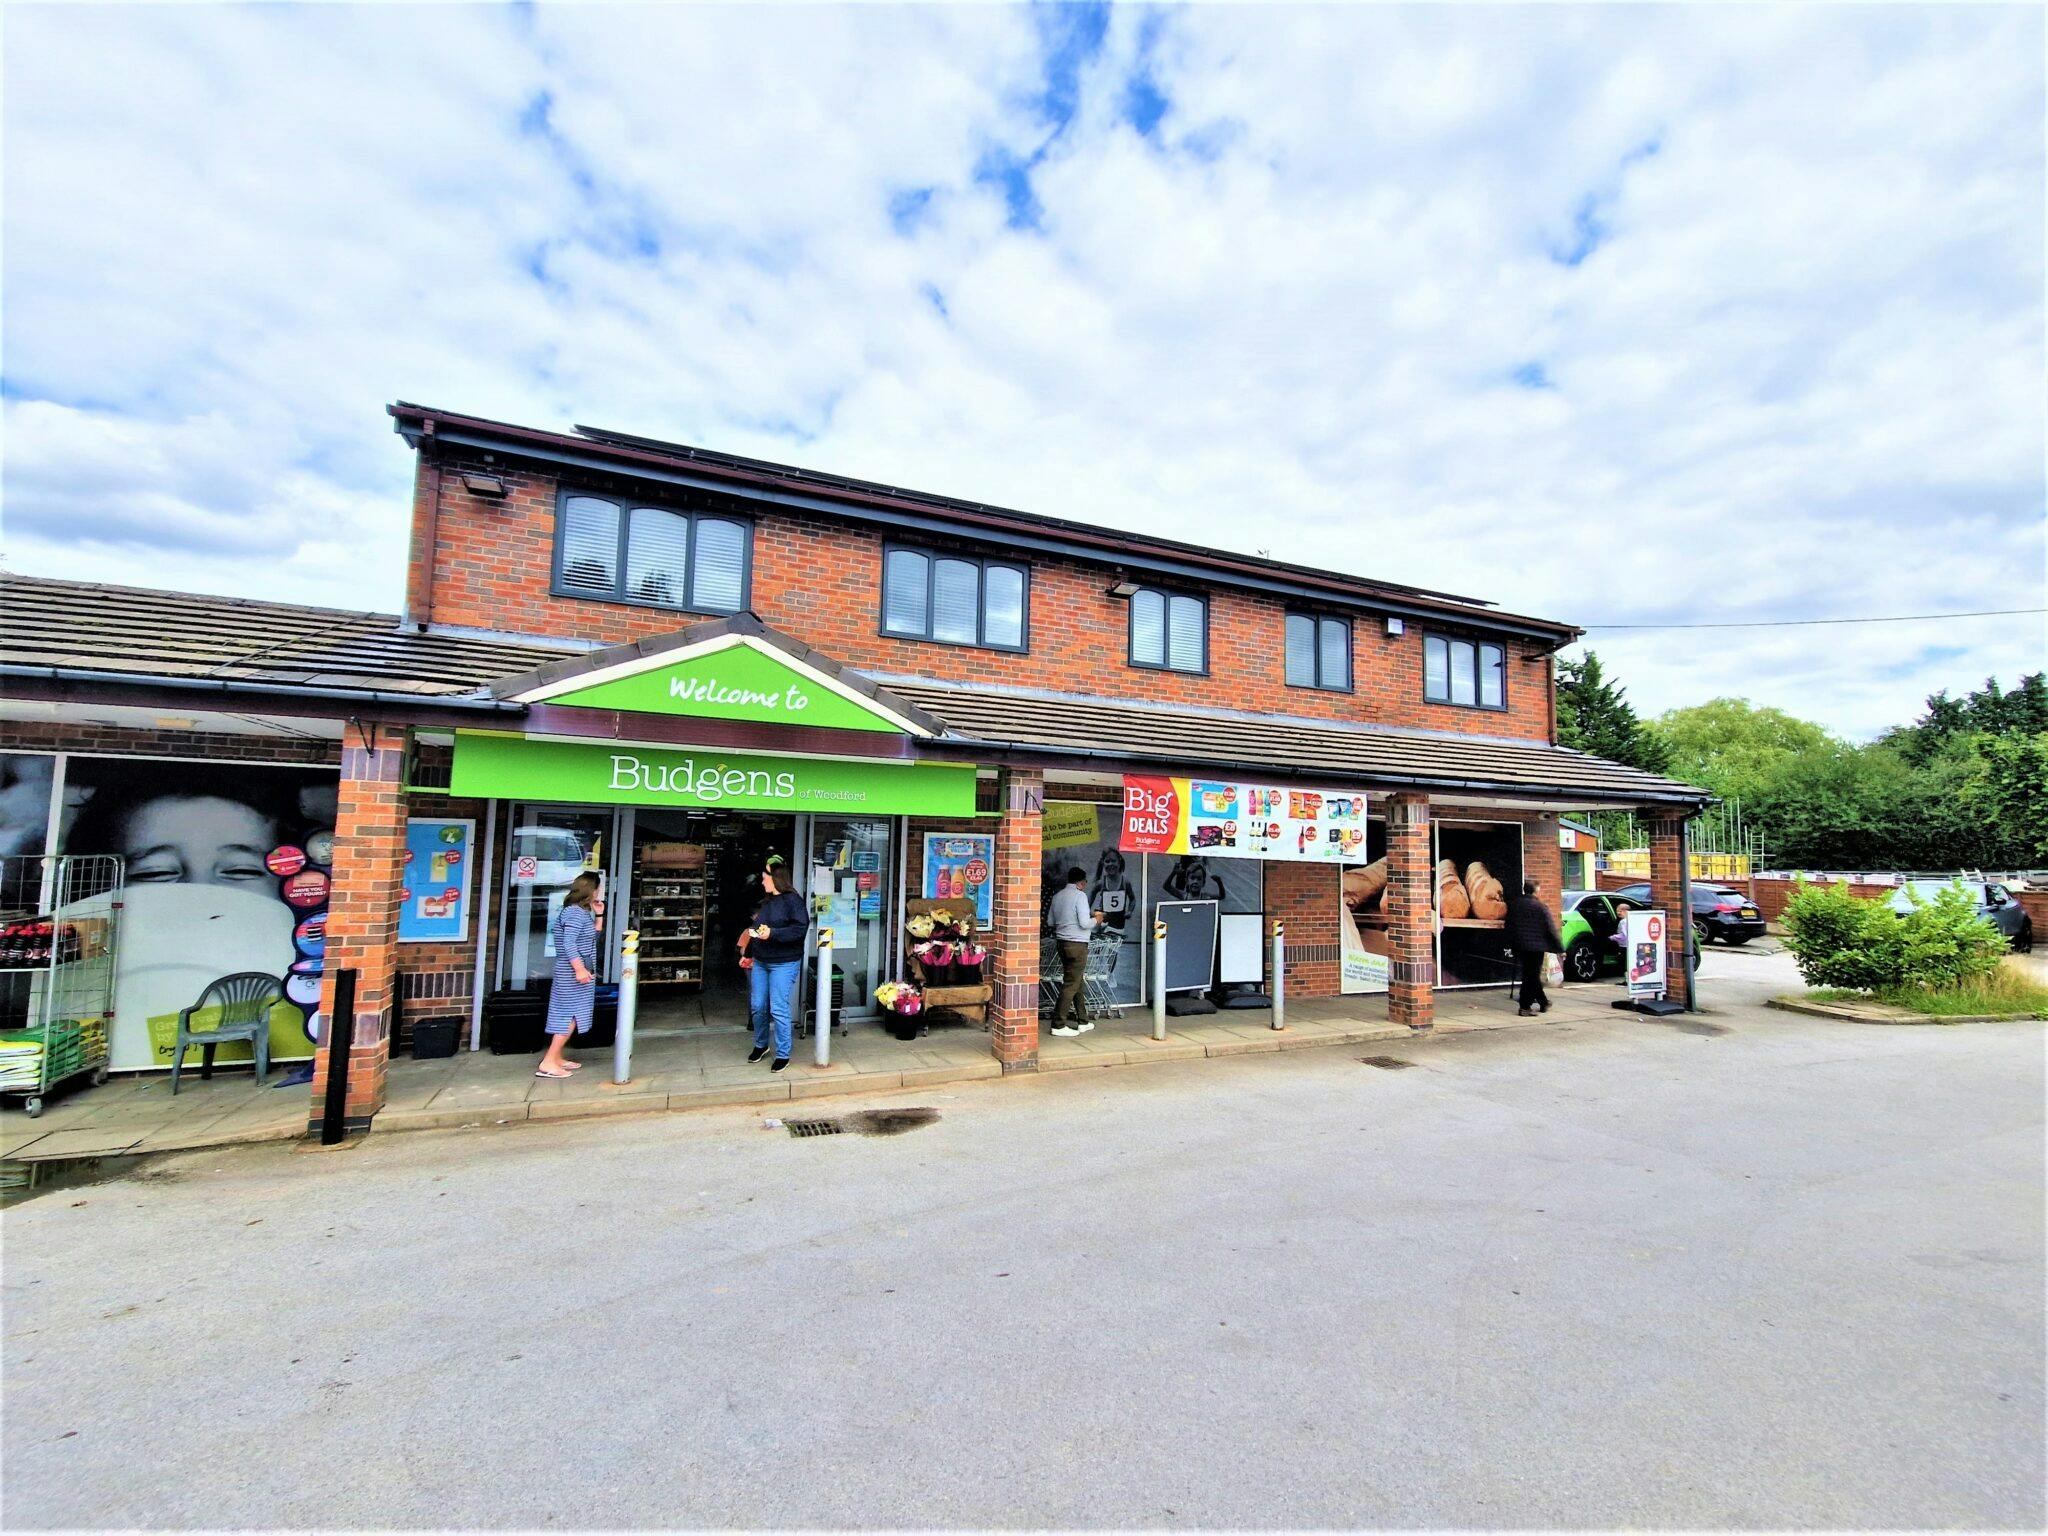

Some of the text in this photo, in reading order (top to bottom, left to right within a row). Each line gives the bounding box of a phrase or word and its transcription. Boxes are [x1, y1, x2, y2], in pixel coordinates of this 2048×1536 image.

[669, 676, 809, 710] Welcome to
[608, 755, 866, 802] Budgens of Woodford
[1124, 787, 1174, 820] Big
[1053, 827, 1093, 840] community
[1129, 816, 1168, 835] DEALS
[966, 868, 987, 877] £1.69
[1111, 895, 1119, 908] 5
